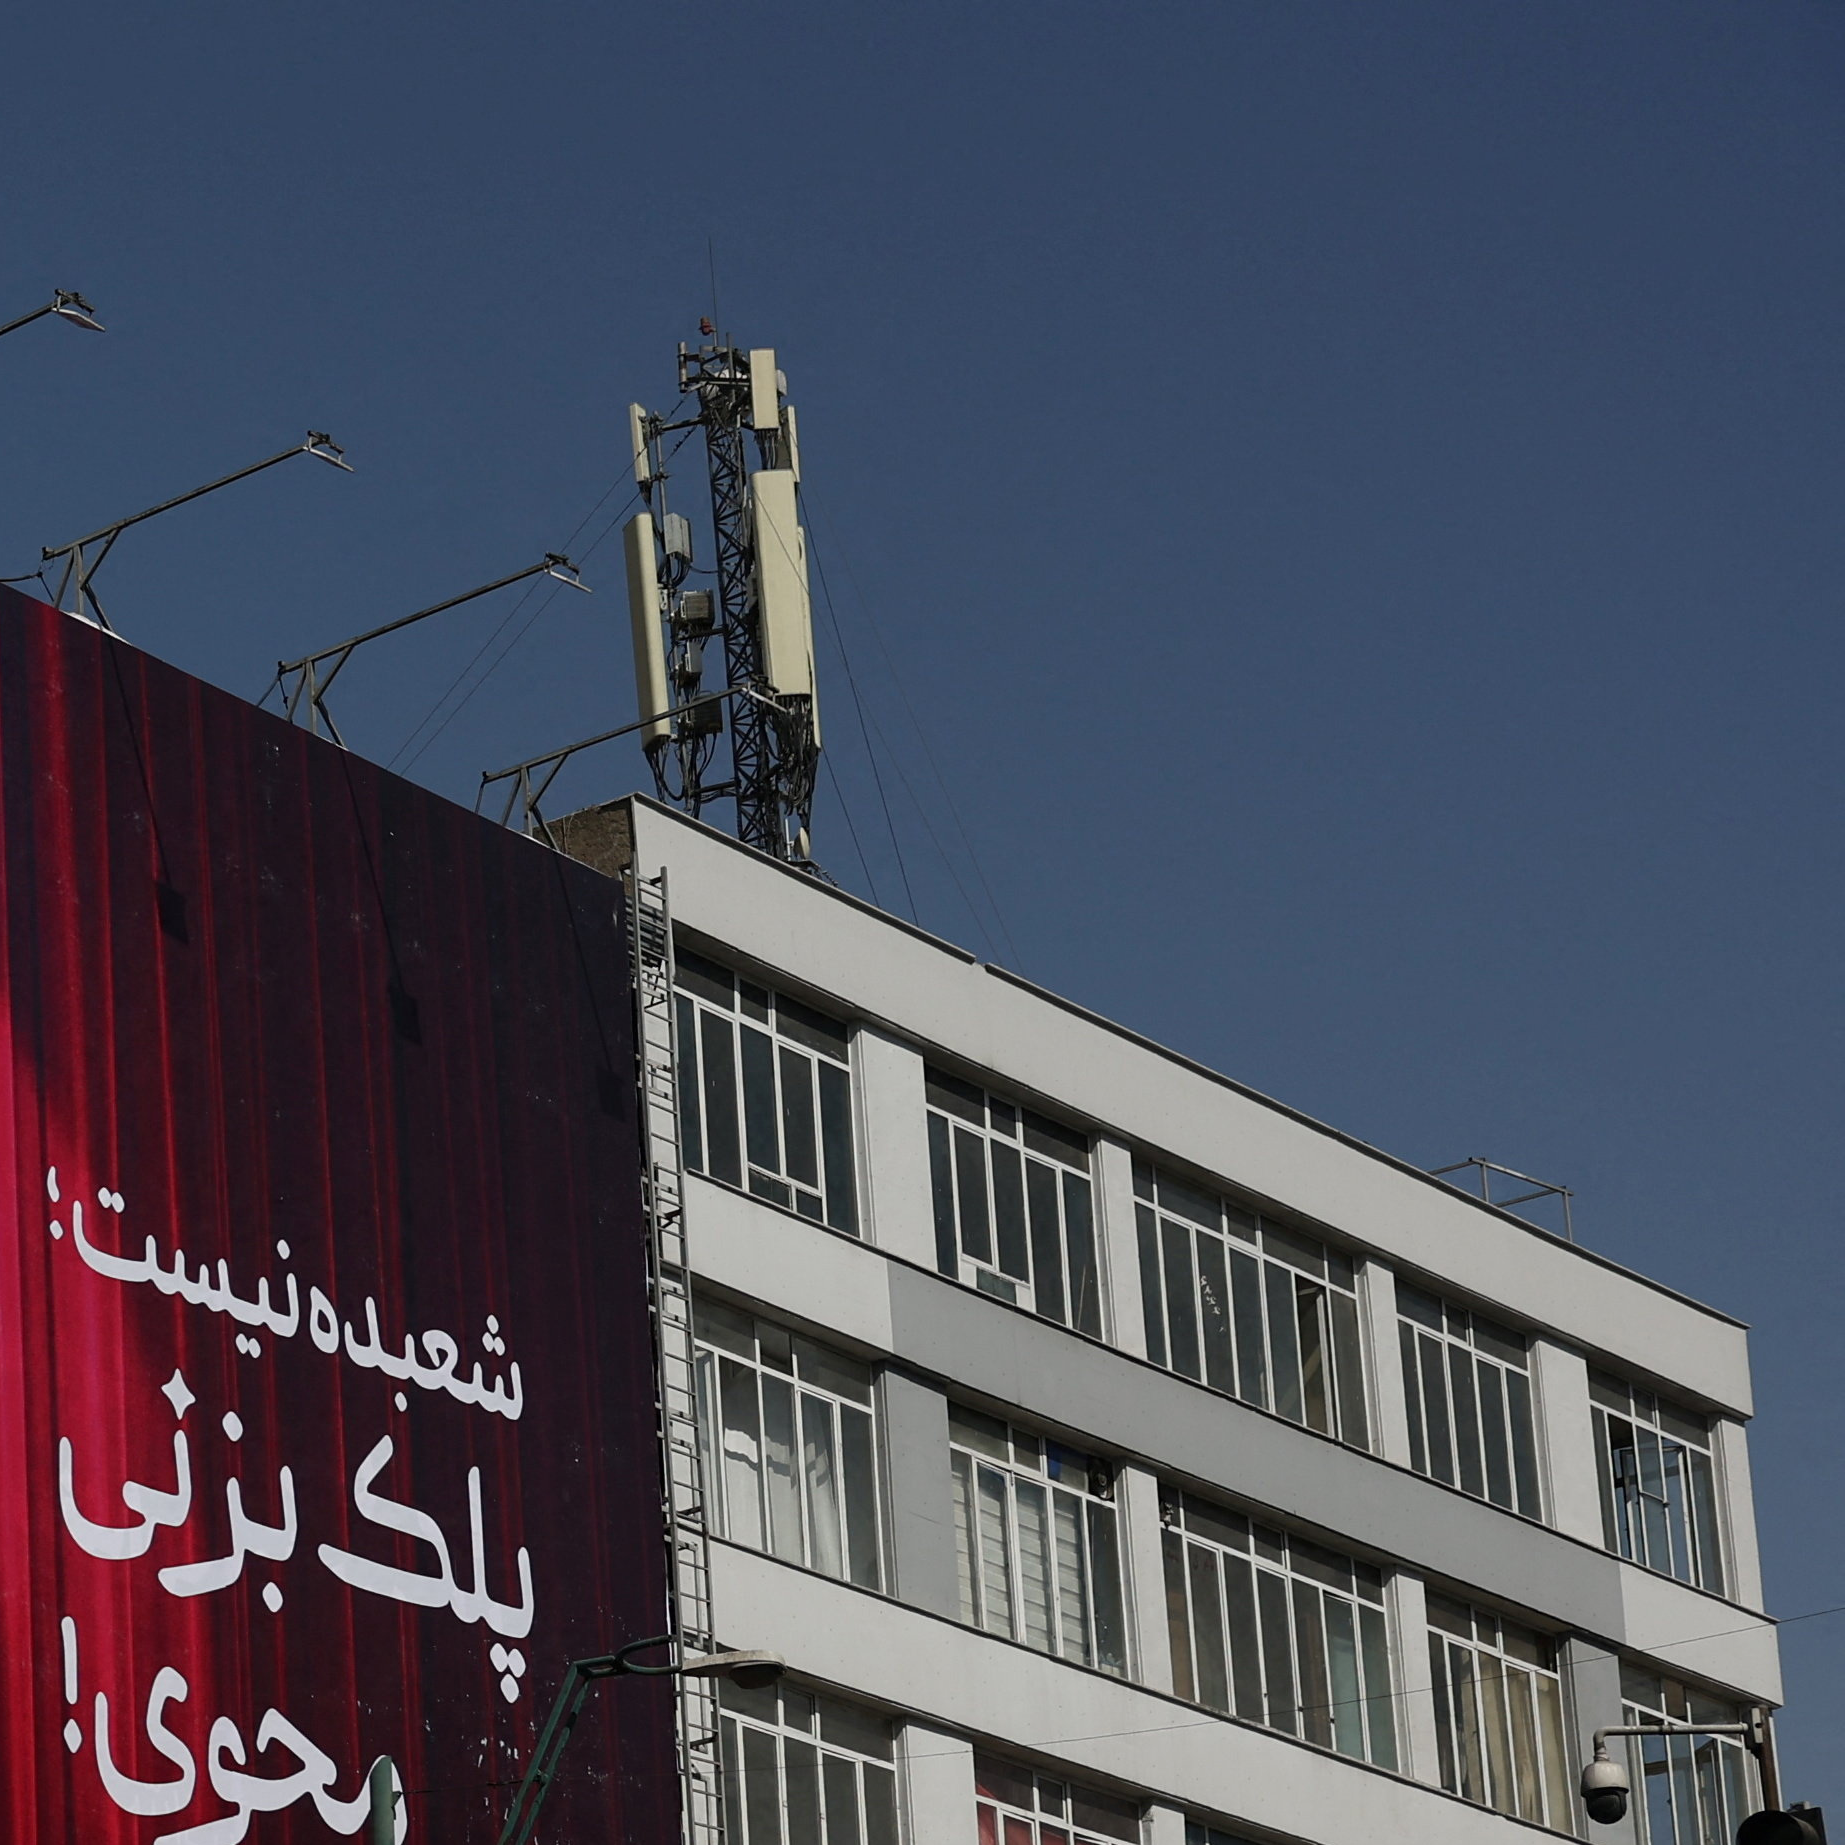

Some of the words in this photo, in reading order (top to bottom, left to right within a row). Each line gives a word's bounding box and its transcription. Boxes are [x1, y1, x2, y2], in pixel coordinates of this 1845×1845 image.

[310, 1287, 523, 1421] شعبده
[58, 1367, 296, 1612] بزنی
[317, 1434, 535, 1704] پلک
